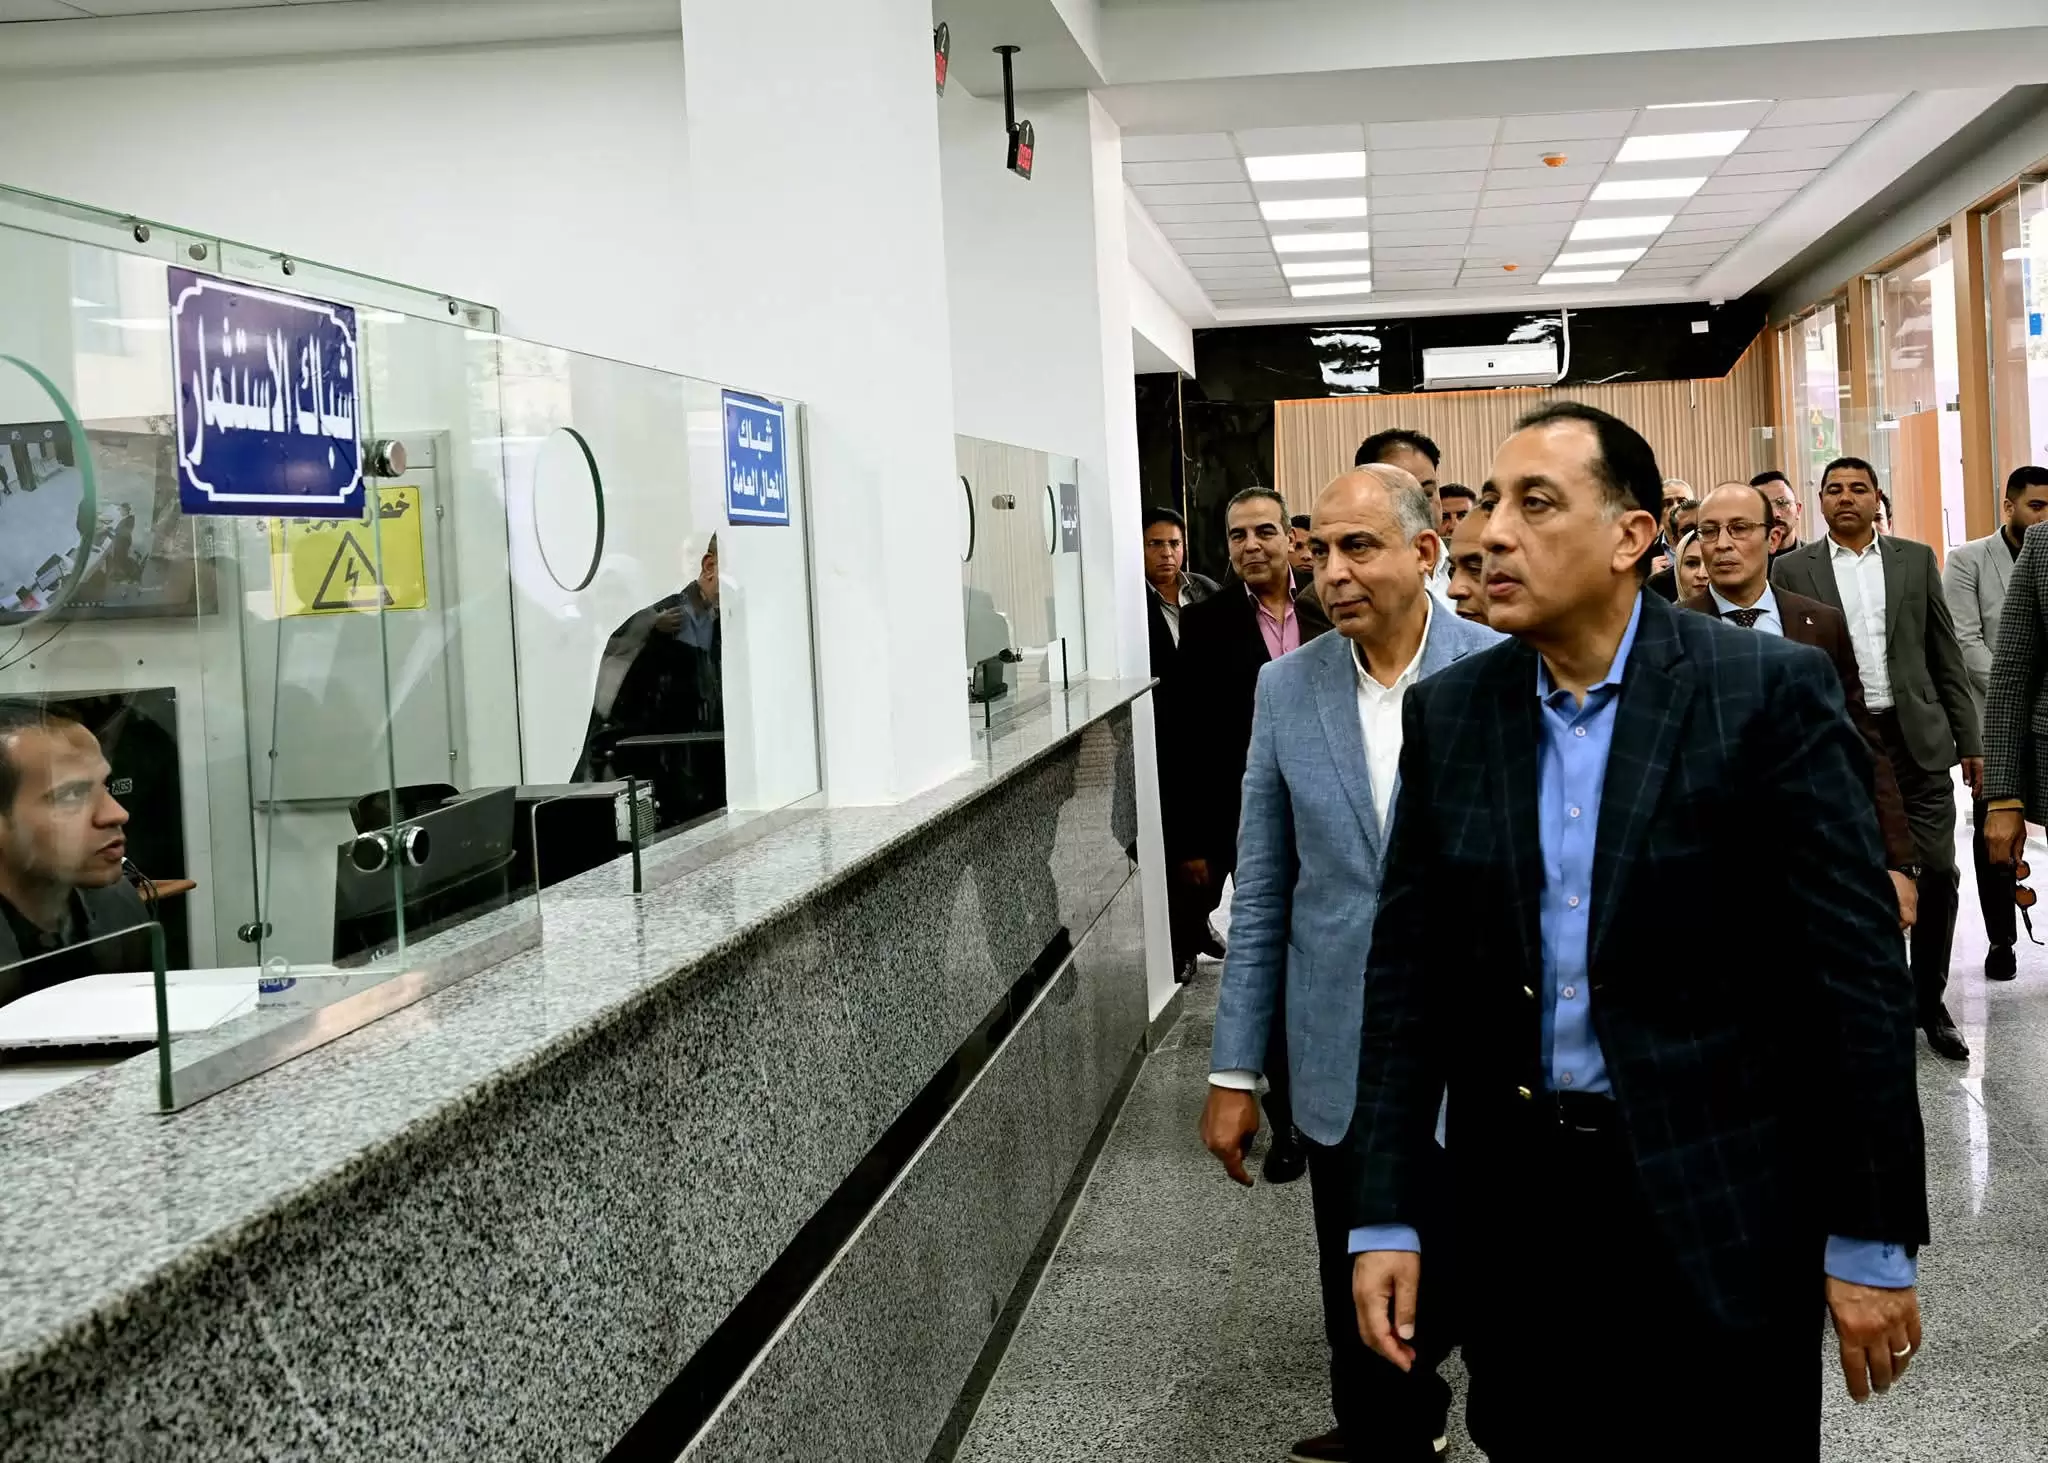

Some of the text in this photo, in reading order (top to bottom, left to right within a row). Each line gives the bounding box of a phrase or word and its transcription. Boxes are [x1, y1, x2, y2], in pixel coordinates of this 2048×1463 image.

[187, 315, 353, 470] شباك الاستثمار
[738, 418, 773, 461] شباك
[732, 460, 759, 497] العامة
